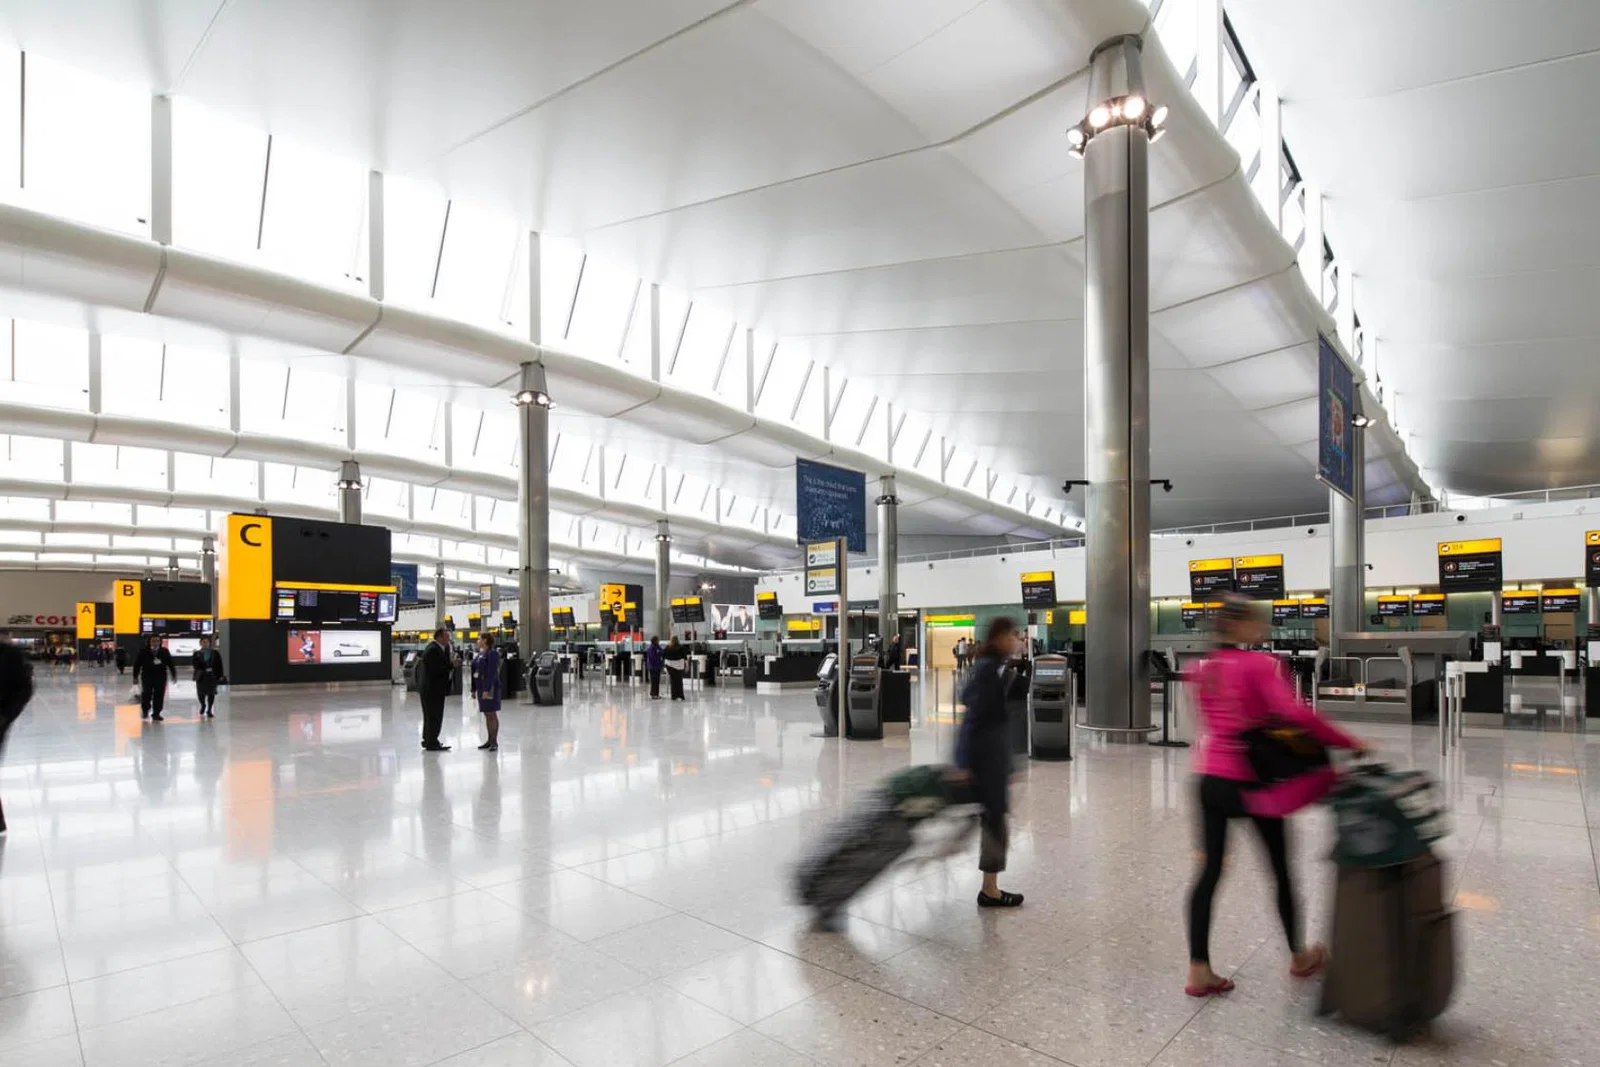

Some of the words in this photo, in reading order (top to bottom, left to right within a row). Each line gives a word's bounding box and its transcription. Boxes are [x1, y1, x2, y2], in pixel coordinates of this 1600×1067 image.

[240, 523, 262, 547] C
[123, 584, 134, 596] B
[81, 605, 91, 613] A
[35, 615, 77, 625] COST
